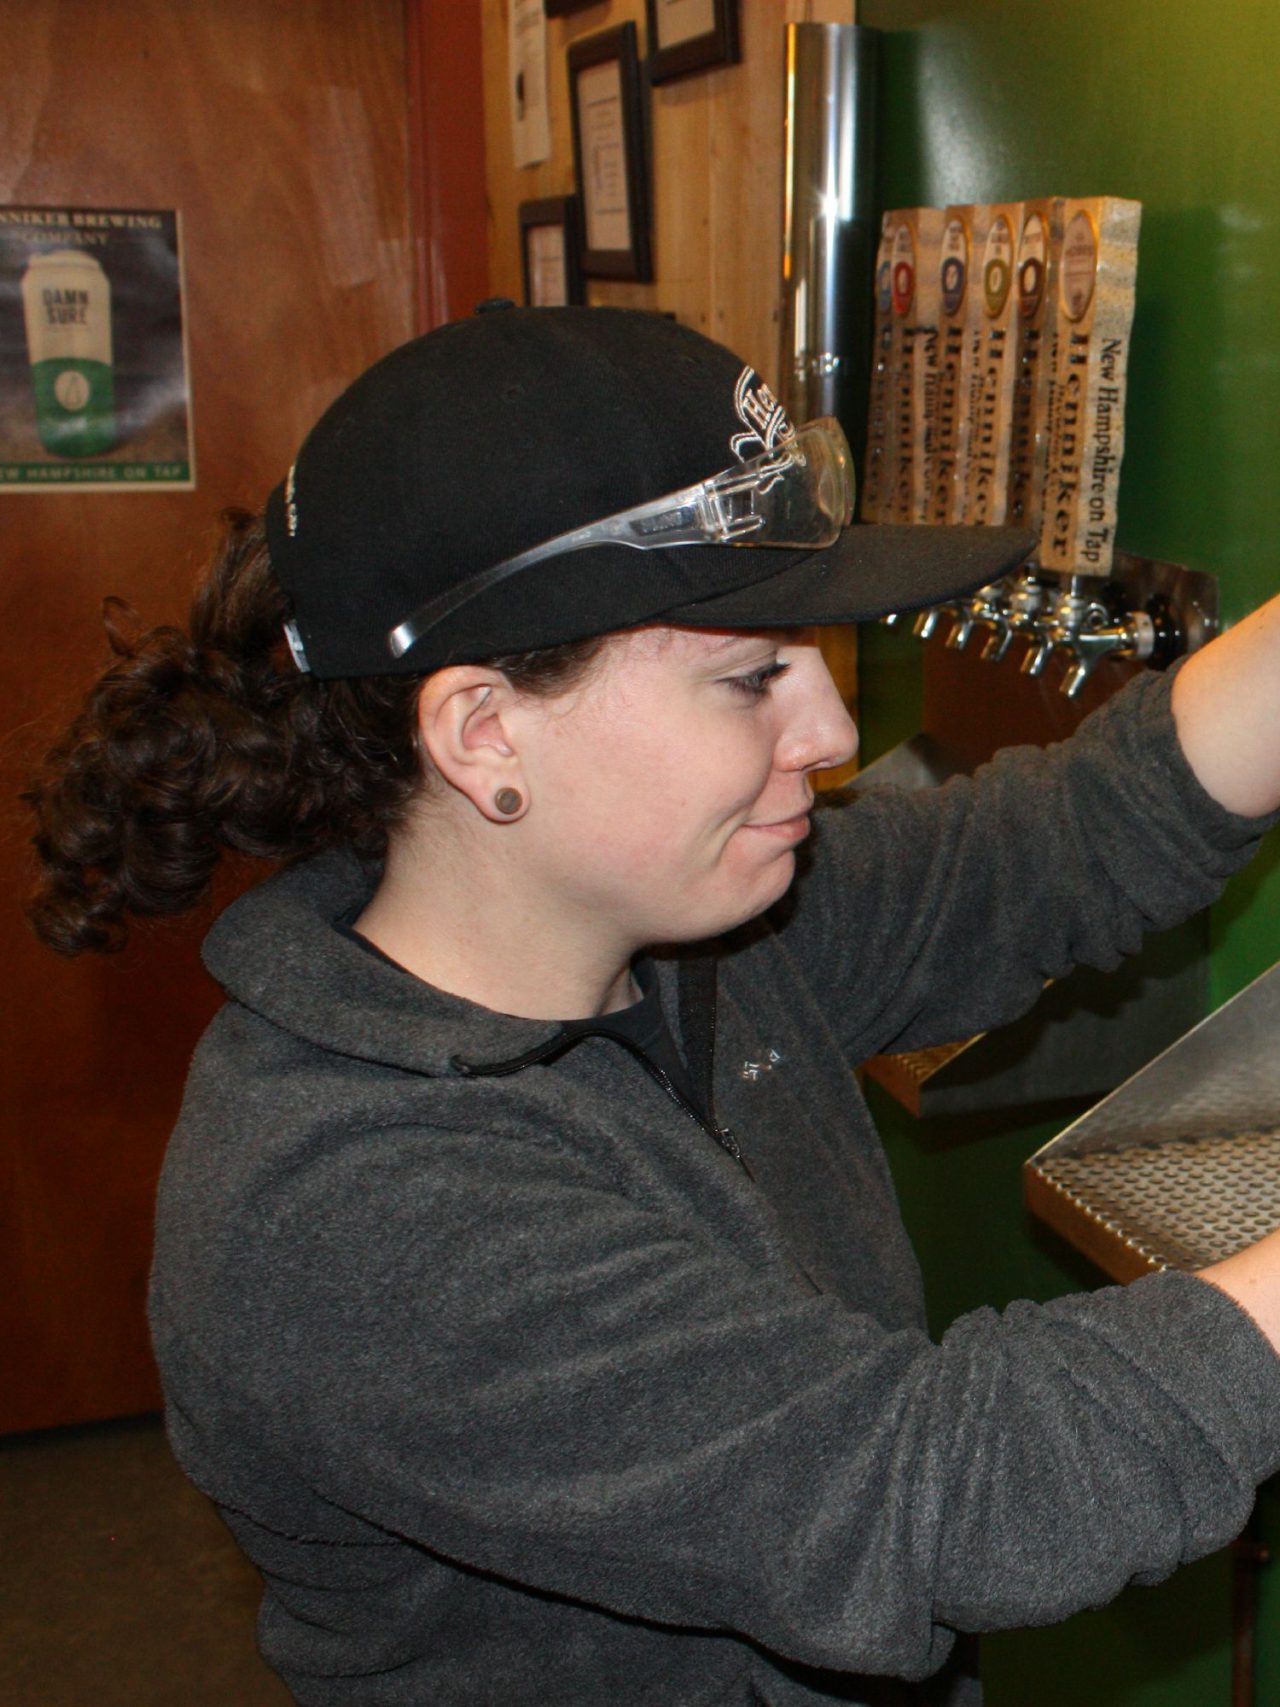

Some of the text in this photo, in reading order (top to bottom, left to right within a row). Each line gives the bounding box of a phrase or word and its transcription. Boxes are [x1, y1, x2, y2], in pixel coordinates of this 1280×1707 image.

[73, 212, 162, 229] BREWING
[26, 231, 109, 246] COMPANY
[42, 289, 89, 306] DAMN
[1053, 334, 1088, 556] Henniker
[1080, 338, 1122, 563] New Hampshire on Tap
[26, 467, 115, 480] HAMPSHIRE
[123, 466, 147, 480] ON
[154, 465, 182, 478] TAP
